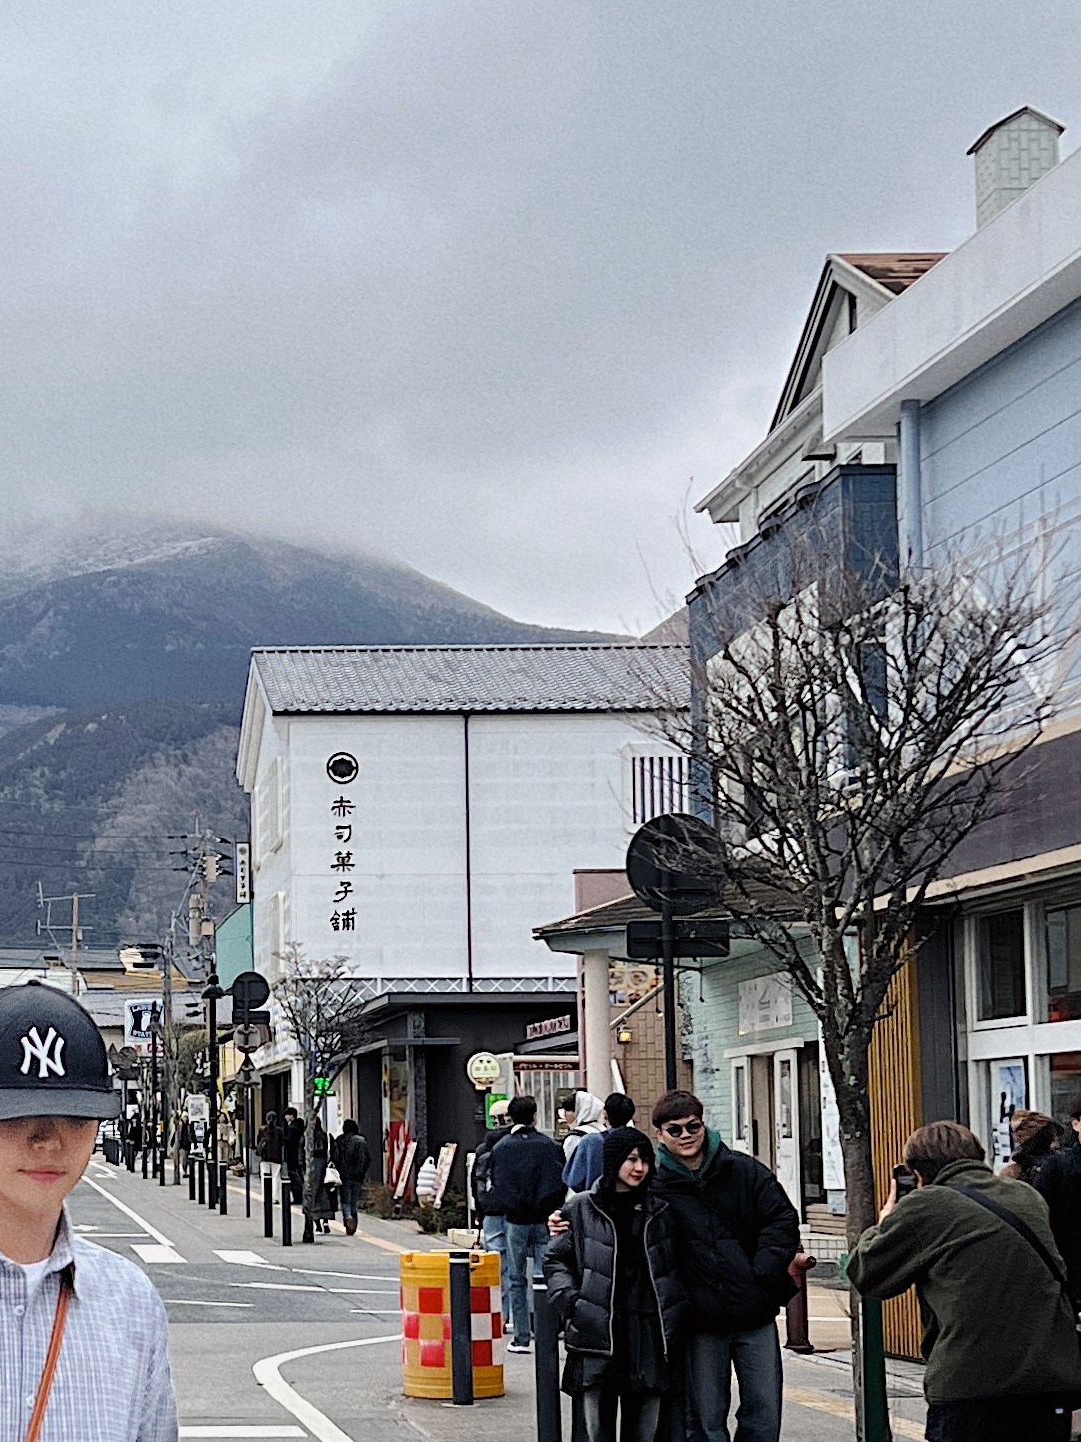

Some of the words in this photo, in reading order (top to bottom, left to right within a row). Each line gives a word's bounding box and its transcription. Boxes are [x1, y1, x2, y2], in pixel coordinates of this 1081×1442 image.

[329, 796, 357, 931] 赤司菓子舗
[20, 1026, 65, 1078] NY
